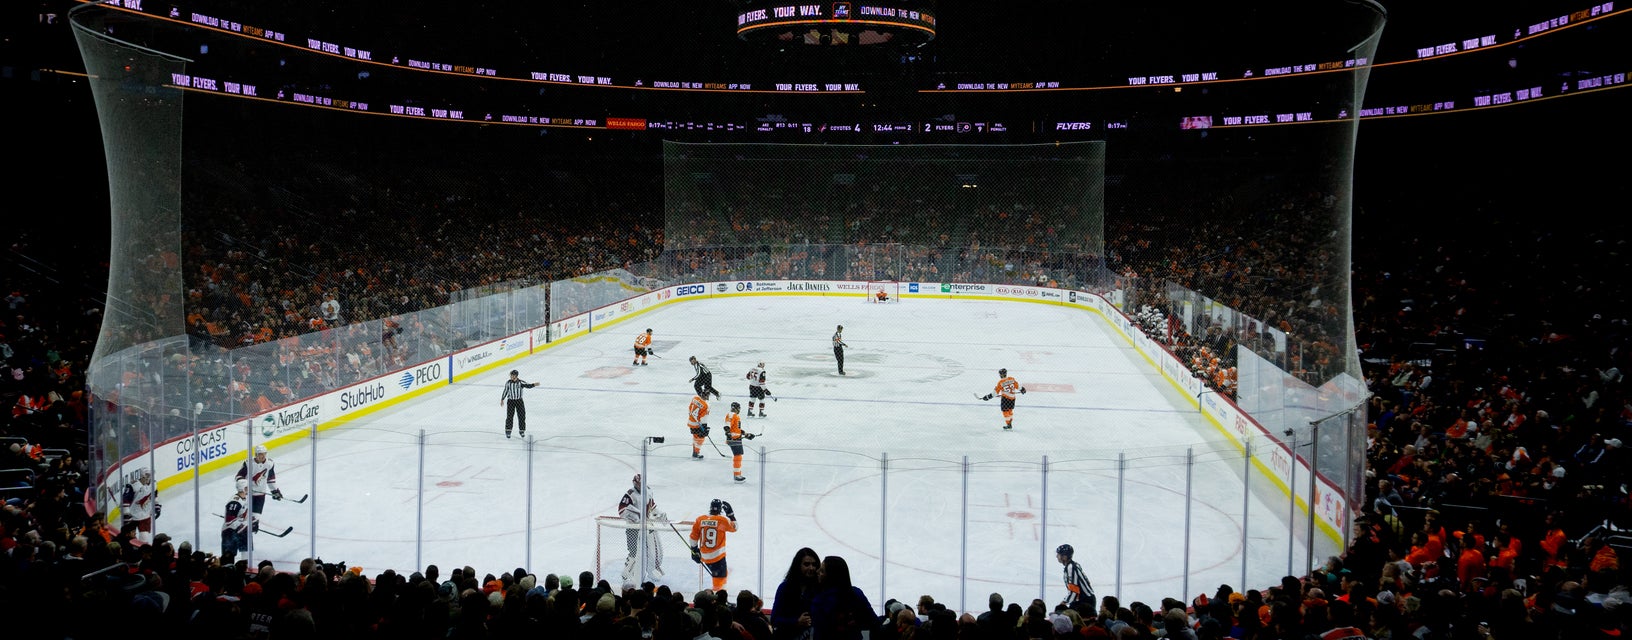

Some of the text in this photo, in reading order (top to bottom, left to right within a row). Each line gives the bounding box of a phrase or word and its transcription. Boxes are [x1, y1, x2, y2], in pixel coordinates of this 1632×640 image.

[746, 9, 768, 22] FLYERS.
[774, 6, 795, 18] YOUR
[800, 4, 822, 16] WAY.
[860, 6, 896, 17] DOWNLOAD
[898, 9, 908, 18] THE
[910, 10, 920, 20] NEW
[1528, 20, 1549, 34] DOWNLOAD
[1550, 18, 1558, 28] THE
[1560, 15, 1568, 26] NEW
[1591, 5, 1600, 16] APP
[1602, 2, 1614, 12] NOW
[192, 13, 218, 27] DOWNLOAD
[220, 19, 229, 30] THE
[230, 22, 242, 32] NEW
[264, 30, 274, 39] APP
[275, 32, 285, 42] NOW
[308, 38, 372, 60] YOUR FLYERS. YOUR WAY.
[1418, 34, 1496, 58] YOUR FLYERS. YOUR WAY.
[408, 59, 430, 70] DOWNLOAD
[432, 62, 440, 70] THE
[1265, 66, 1292, 76] DOWNLOAD
[1294, 65, 1302, 73] THE
[1304, 64, 1316, 72] NEW
[1345, 60, 1355, 68] APP
[172, 73, 257, 96] YOUR FLYERS. YOUR WAY.
[531, 72, 612, 85] YOUR FLYERS. YOUR WAY.
[1128, 72, 1218, 85] YOUR FLYERS. YOUR WAY.
[1474, 86, 1543, 106] YOUR FLYERS. YOUR WAY.
[390, 104, 464, 120] YOUR FLYERS. YOUR WAY.
[502, 114, 528, 122] DOWNLOAD
[1224, 112, 1312, 125] YOUR FLYERS. YOUR WAY.
[854, 124, 861, 132] 4
[925, 124, 932, 132] 2
[676, 285, 704, 296] GEICO
[787, 282, 803, 290] JACK
[943, 283, 986, 292] enterprise
[416, 363, 440, 386] PECO
[340, 382, 385, 412] StubHub
[277, 403, 320, 429] NovaCare
[176, 428, 227, 454] COMCAST
[177, 442, 227, 472] BUSINESS
[701, 528, 718, 549] 19
